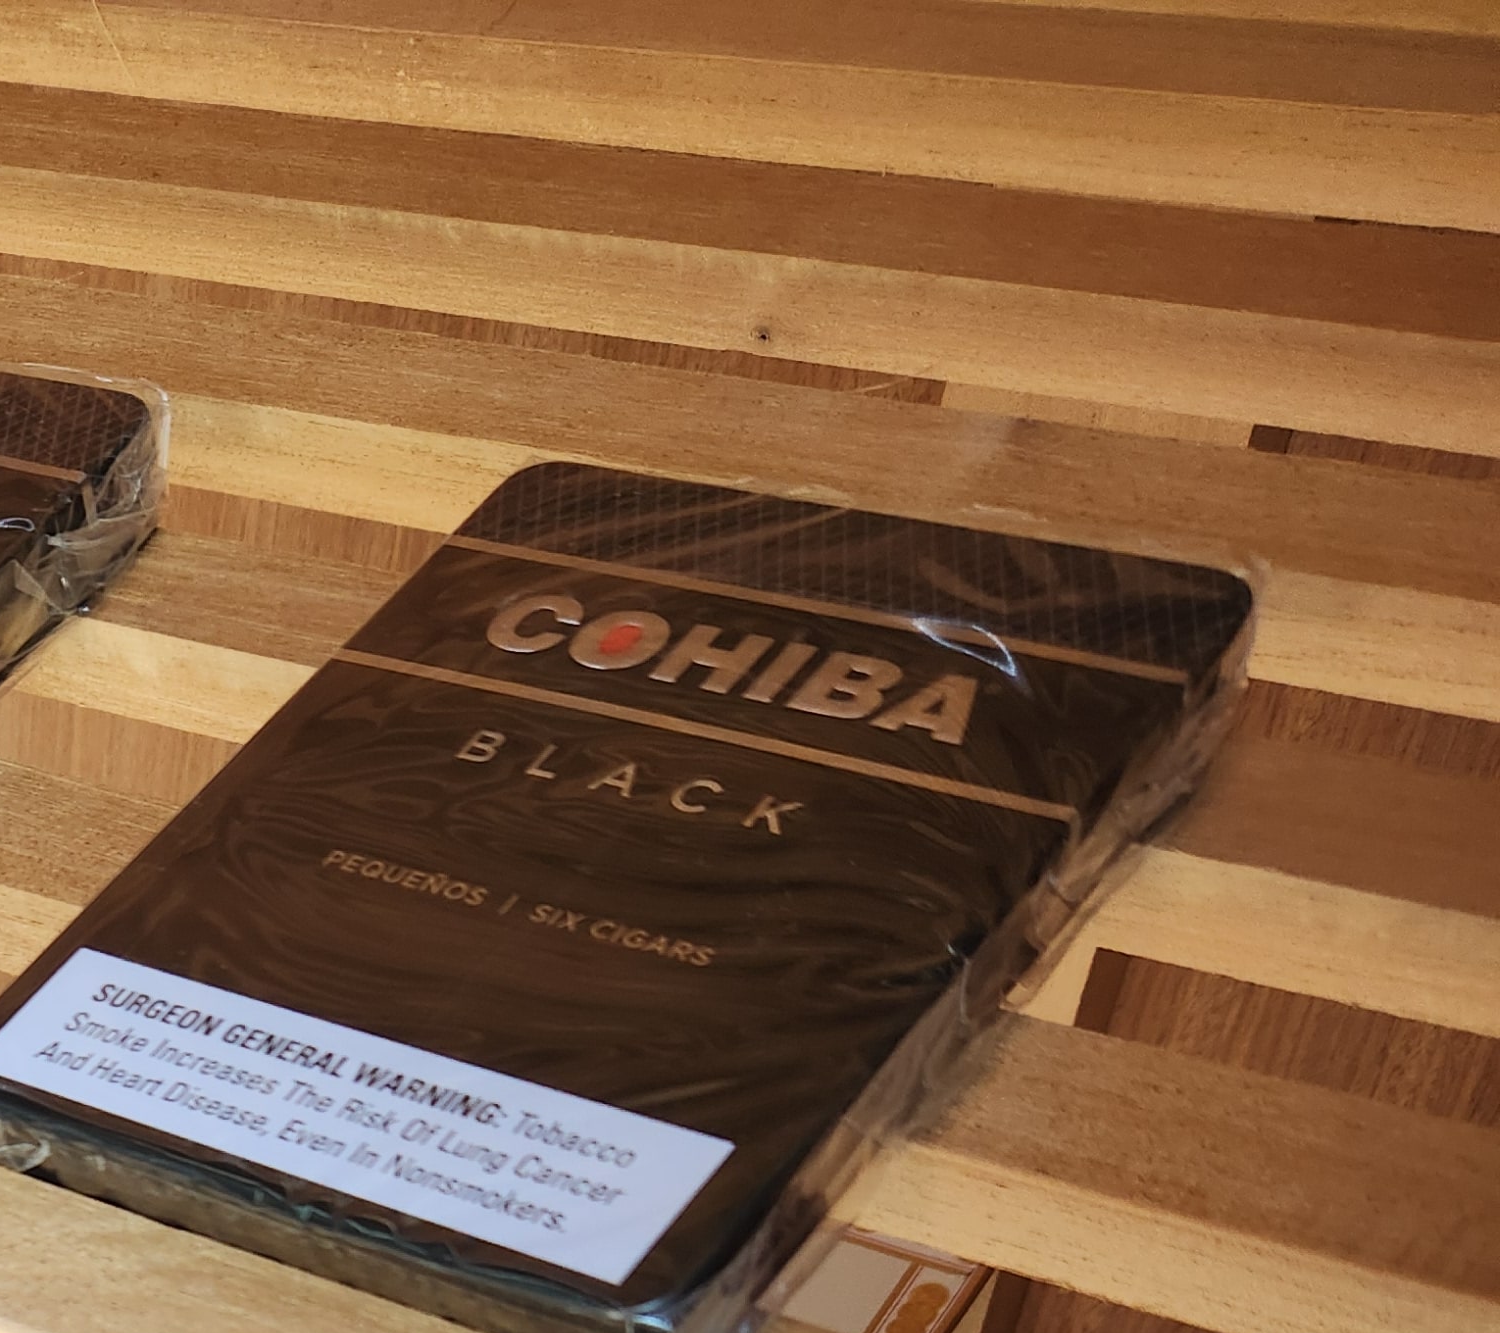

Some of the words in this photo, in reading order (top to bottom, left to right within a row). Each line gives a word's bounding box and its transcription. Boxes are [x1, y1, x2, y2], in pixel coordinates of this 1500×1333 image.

[485, 593, 980, 746] COHIBA
[454, 728, 803, 836] BLACK
[320, 847, 489, 907] PEQUEÑOS
[527, 901, 579, 933] SIX
[587, 917, 717, 969] CIGARS
[33, 1041, 89, 1073] And
[89, 1057, 169, 1100] Heart
[163, 1079, 272, 1140] Disease,
[275, 1119, 344, 1161] Even
[346, 1140, 382, 1168] In
[382, 1153, 570, 1235] Nonsmokers.
[62, 1010, 150, 1055] Smoke
[149, 1039, 282, 1099] Increases
[284, 1078, 335, 1114] The
[334, 1098, 399, 1136] Risk
[400, 1118, 442, 1145] Of
[436, 1127, 509, 1178] Lung
[511, 1152, 629, 1209] Cancer
[91, 983, 222, 1038] SURGEON
[222, 1023, 344, 1081] GENERAL
[353, 1060, 509, 1131] WARNING:
[510, 1110, 638, 1170] Tobacco
